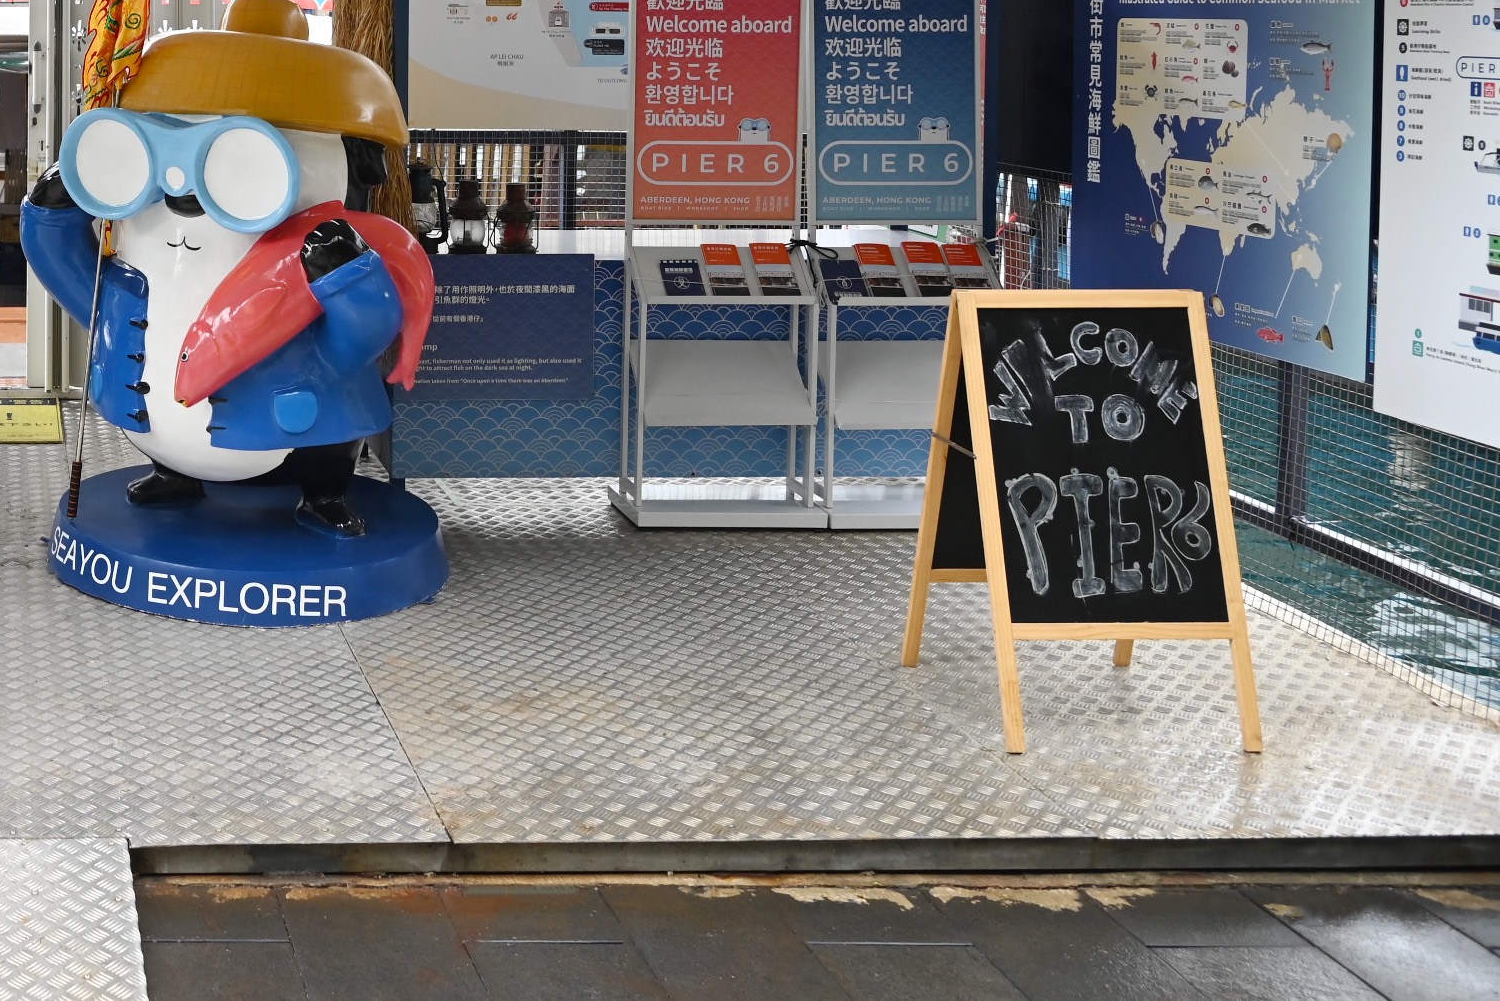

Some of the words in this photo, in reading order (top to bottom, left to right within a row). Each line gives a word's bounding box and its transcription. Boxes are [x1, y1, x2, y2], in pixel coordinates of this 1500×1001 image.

[646, 15, 729, 34] Welcome
[731, 15, 792, 34] aboard
[825, 15, 905, 33] Welcome
[908, 15, 968, 33] aboard
[646, 38, 723, 58] 欢迎光临
[825, 38, 902, 58] 欢迎光临
[646, 61, 721, 81] ようこそ
[826, 61, 900, 81] ようこそ
[1461, 63, 1496, 73] PIER
[645, 84, 734, 105] 환영합니다
[826, 84, 913, 105] 환영합니다
[644, 110, 725, 127] ยินดีต้อนรับ
[826, 110, 905, 127] ยินดีต้อนรับ
[652, 153, 743, 173] PIER
[764, 153, 779, 173] 6
[833, 153, 925, 173] PIER
[944, 152, 959, 173] 6
[640, 196, 692, 204] ABERDEEN,
[822, 197, 875, 205] ABERDEEN,
[454, 364, 465, 372] fish
[516, 364, 534, 373] night.
[473, 358, 486, 367] only
[1054, 393, 1146, 444] TO
[1005, 467, 1192, 598] PIER
[1171, 480, 1212, 561] 6
[50, 525, 133, 594] SEAYOU
[148, 572, 347, 617] EXPLORER
